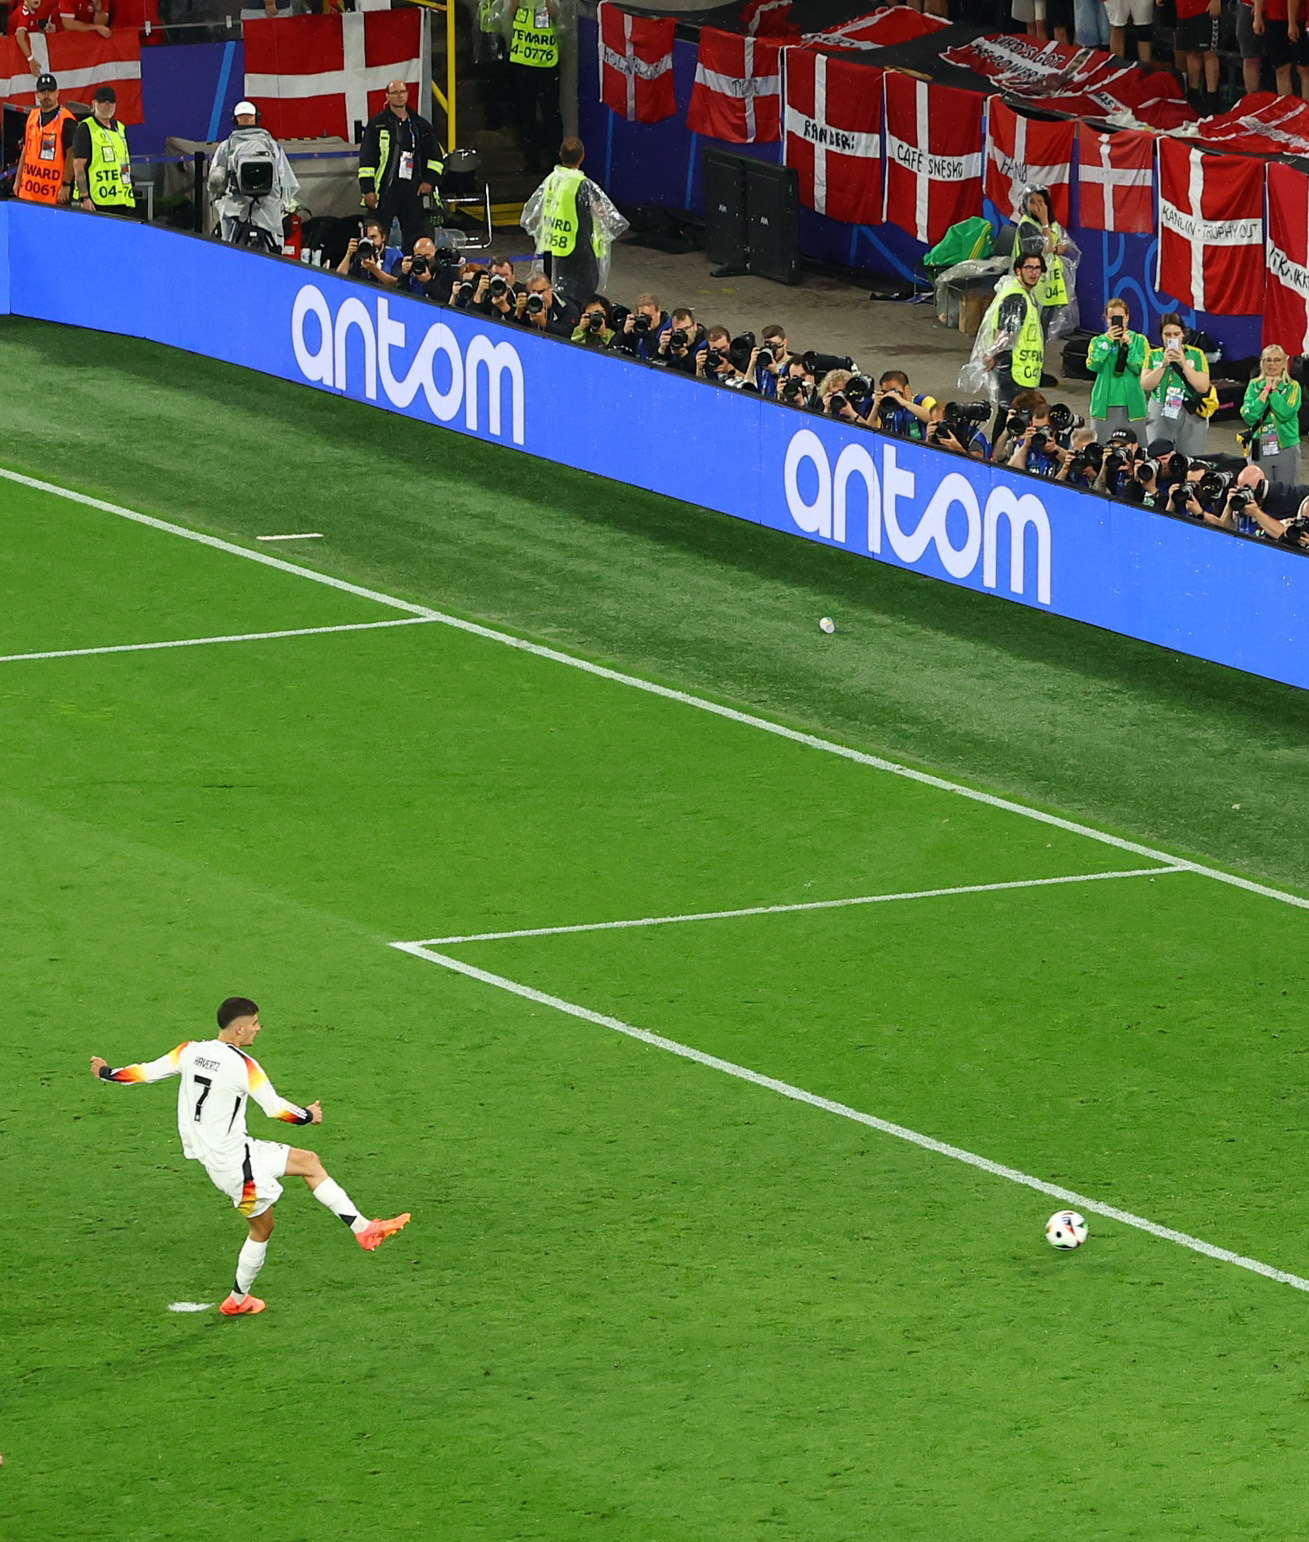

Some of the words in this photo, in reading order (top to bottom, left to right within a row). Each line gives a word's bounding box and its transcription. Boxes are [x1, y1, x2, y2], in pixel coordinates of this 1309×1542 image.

[291, 283, 525, 447] antom
[784, 429, 1051, 605] antom
[193, 1074, 213, 1122] 7
